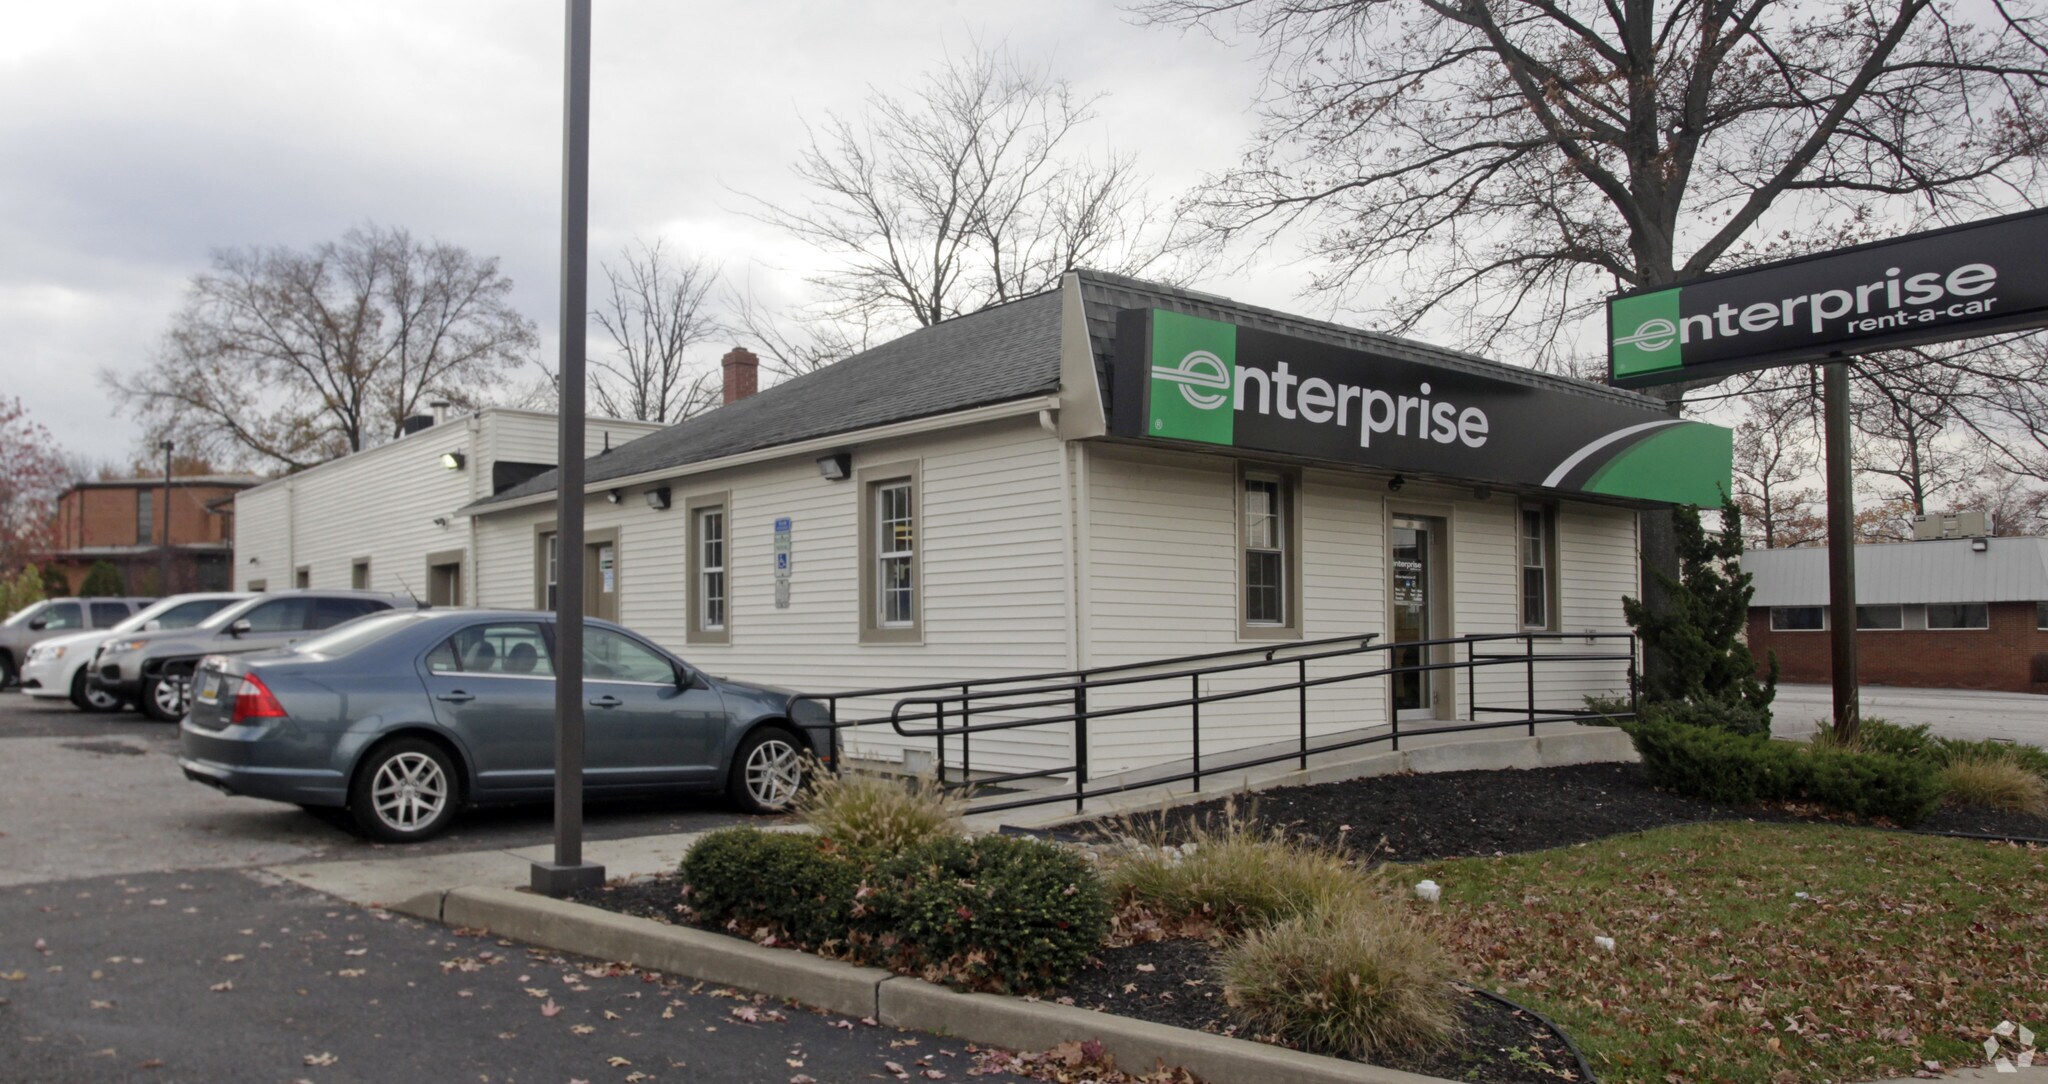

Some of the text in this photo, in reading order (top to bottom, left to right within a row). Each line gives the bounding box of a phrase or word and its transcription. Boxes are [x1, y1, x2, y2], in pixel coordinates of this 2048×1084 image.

[1612, 263, 1998, 352] enterprise
[1847, 297, 1998, 334] rent-a-car
[1151, 350, 1490, 449] enterprise
[1393, 560, 1422, 569] nterprise
